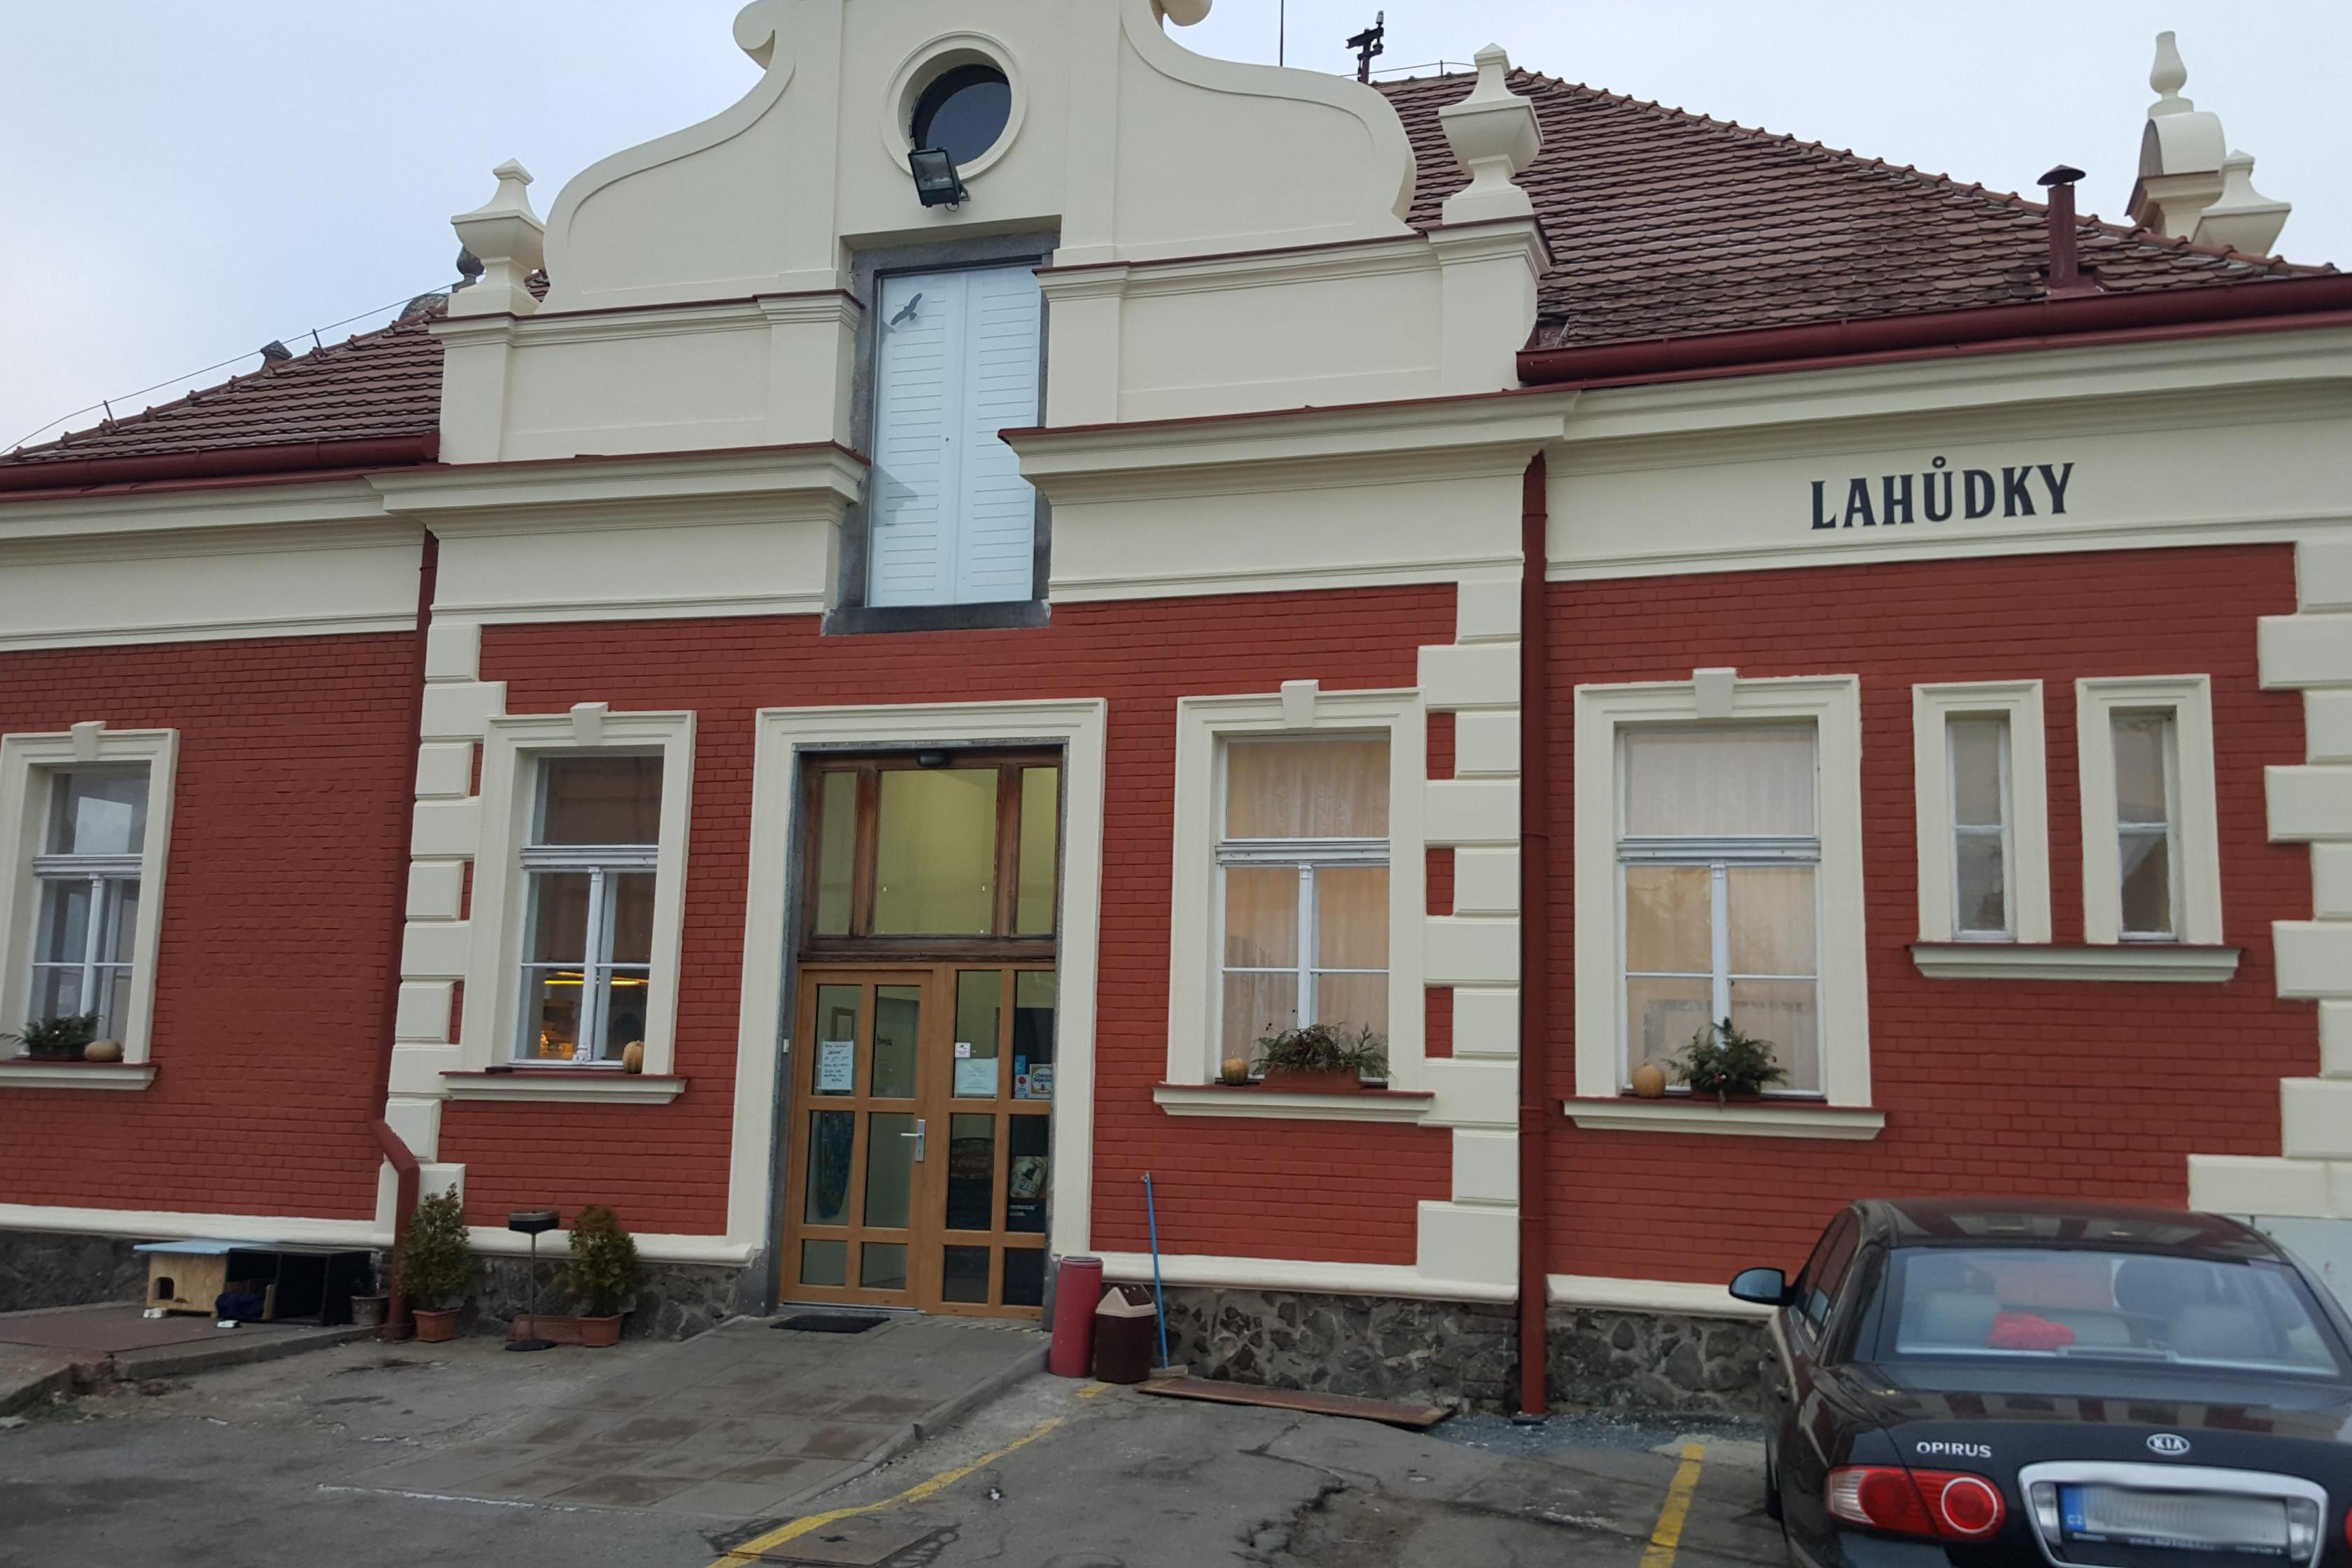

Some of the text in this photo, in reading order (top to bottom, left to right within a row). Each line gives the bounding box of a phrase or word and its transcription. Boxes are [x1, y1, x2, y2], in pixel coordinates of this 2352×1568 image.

[1811, 455, 2075, 529] LAHŮDKY
[1916, 1441, 1992, 1458] OPIRUS
[2154, 1437, 2183, 1449] KIA
